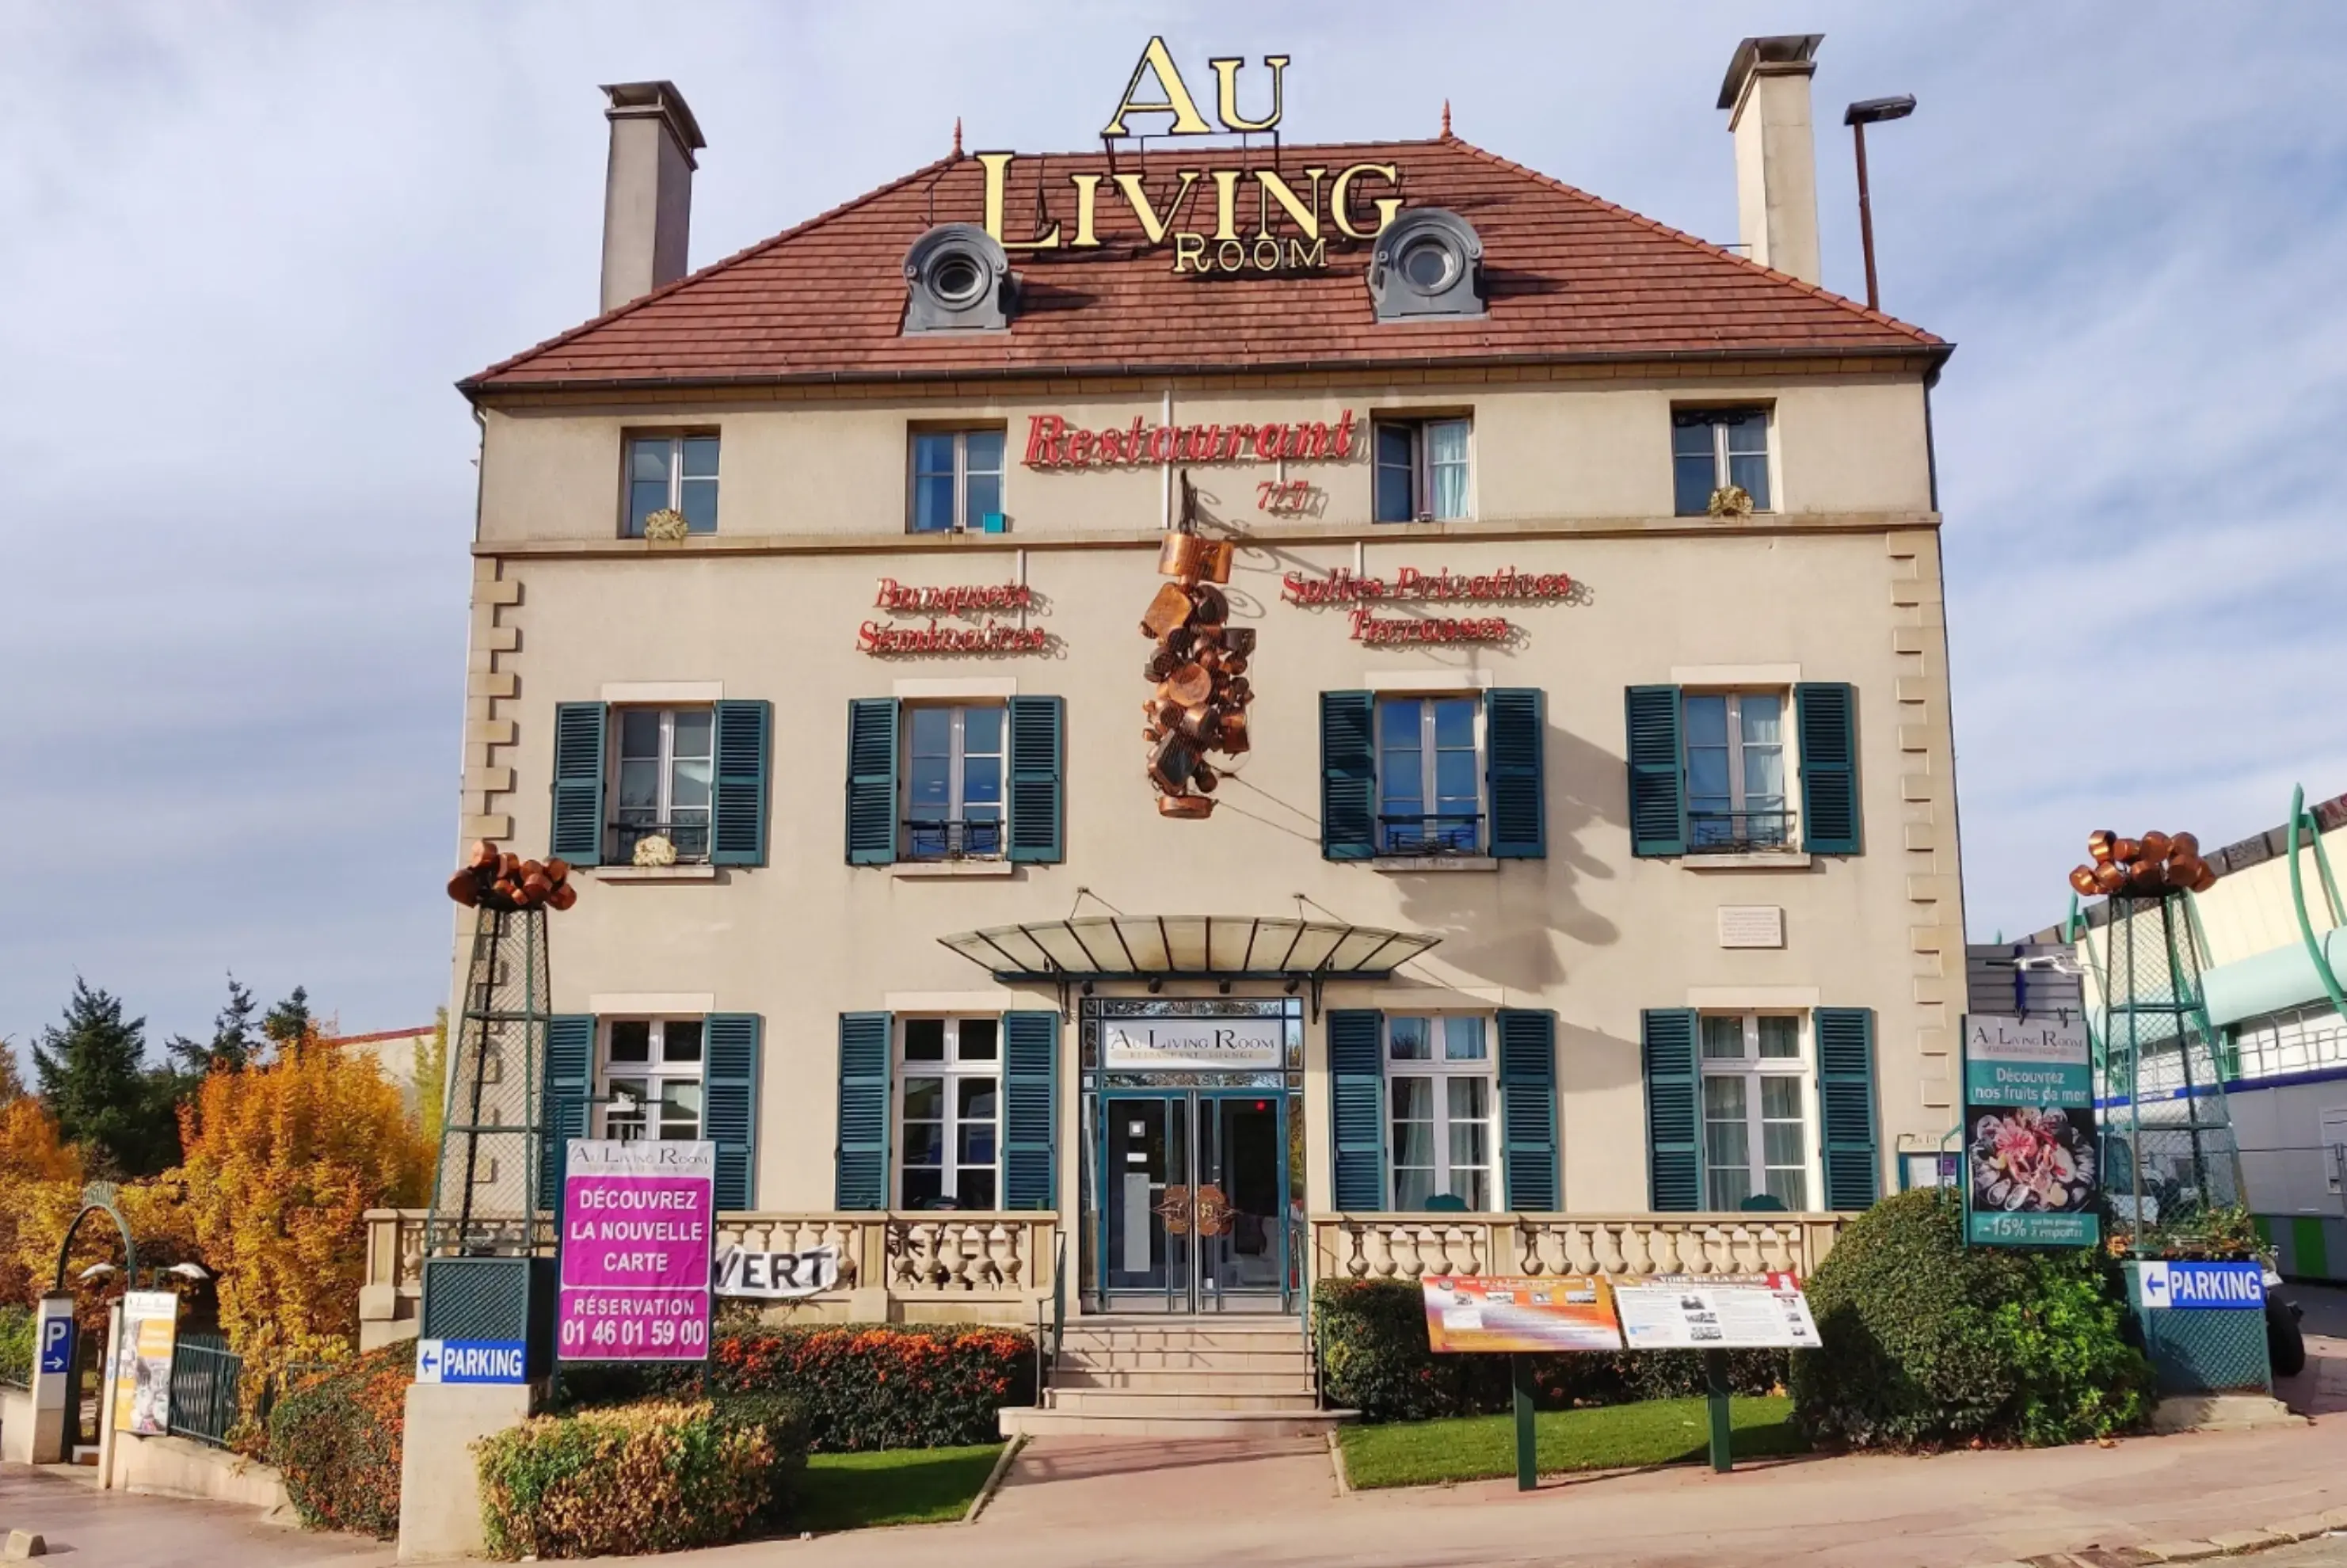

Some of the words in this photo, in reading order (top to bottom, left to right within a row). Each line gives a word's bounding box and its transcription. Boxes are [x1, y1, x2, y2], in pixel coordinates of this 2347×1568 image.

[1020, 409, 1357, 466] Restaurant
[1255, 480, 1309, 511] 7/7
[872, 577, 1031, 616] Banquets
[1281, 565, 1385, 604] Salles
[1396, 564, 1572, 600] Privatives
[1348, 608, 1508, 643] Terrasses
[1996, 1067, 2065, 1084] Découvrez
[1975, 1087, 2000, 1099] nos
[2004, 1085, 2039, 1100] fruits
[2062, 1090, 2087, 1102] mer
[579, 1186, 698, 1210] DÉCOUVREZ
[570, 1221, 595, 1240] LA
[600, 1221, 703, 1241] NOUVELLE
[604, 1252, 668, 1272] CARTE
[2170, 1270, 2261, 1300] PARKING
[573, 1296, 694, 1315] RÉSERVATION
[46, 1322, 67, 1352] P
[562, 1319, 585, 1345] 01
[592, 1320, 616, 1345] 46
[622, 1320, 644, 1345] 01
[651, 1320, 675, 1345] 59
[680, 1320, 704, 1345] 00
[444, 1348, 523, 1377] PARKING
